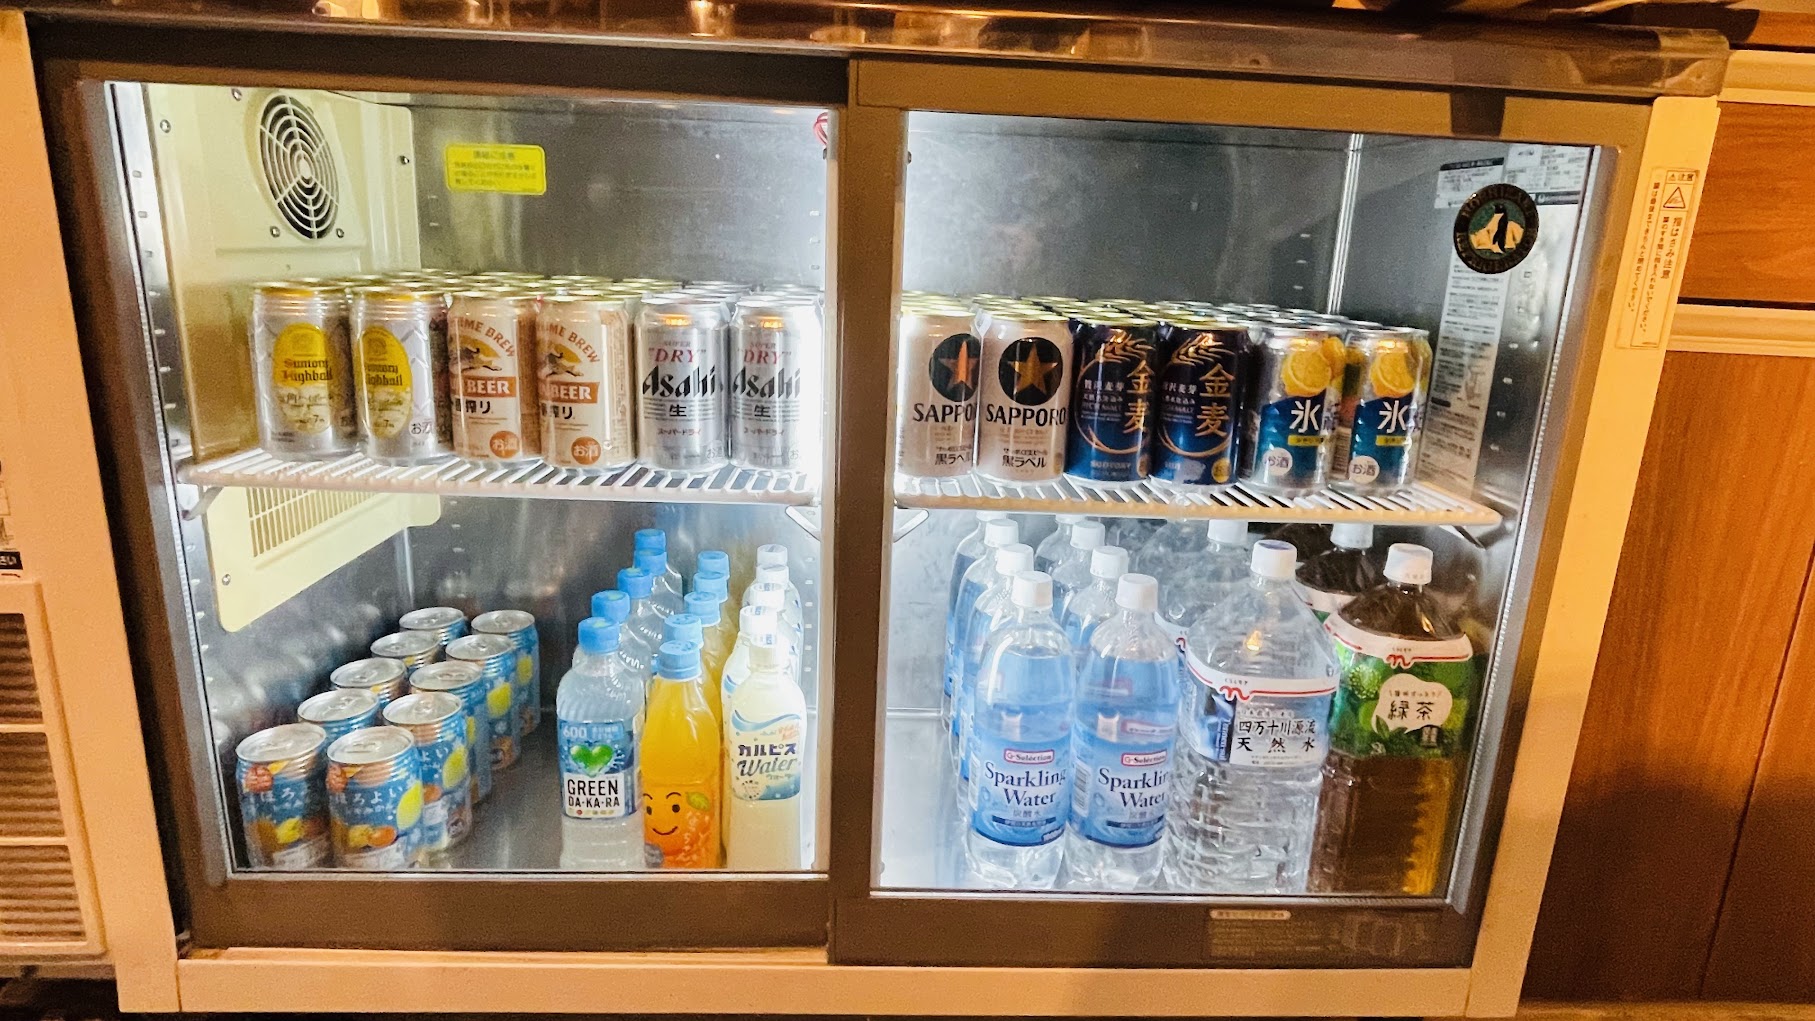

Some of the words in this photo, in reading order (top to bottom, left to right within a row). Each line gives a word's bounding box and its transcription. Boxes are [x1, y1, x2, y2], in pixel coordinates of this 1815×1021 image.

[568, 331, 601, 363] BREW
[466, 380, 511, 394] BEER
[642, 364, 716, 398] Asahi
[732, 366, 801, 399] Asahi
[1123, 359, 1155, 435] 金麦
[1194, 363, 1236, 438] 金麦
[669, 404, 687, 417] 生
[754, 405, 771, 418] 生
[986, 404, 1066, 427] SAPPORO
[1289, 399, 1321, 433] 氷
[1377, 399, 1411, 434] 氷
[1002, 454, 1047, 468] 黒ラベル
[1352, 463, 1377, 475] お酒
[1387, 700, 1434, 720] 緑茶
[738, 742, 797, 757] カルピス
[736, 756, 798, 777] Water
[984, 761, 1067, 788] Sparkling
[567, 778, 619, 796] GREEN
[1003, 787, 1057, 807] Water
